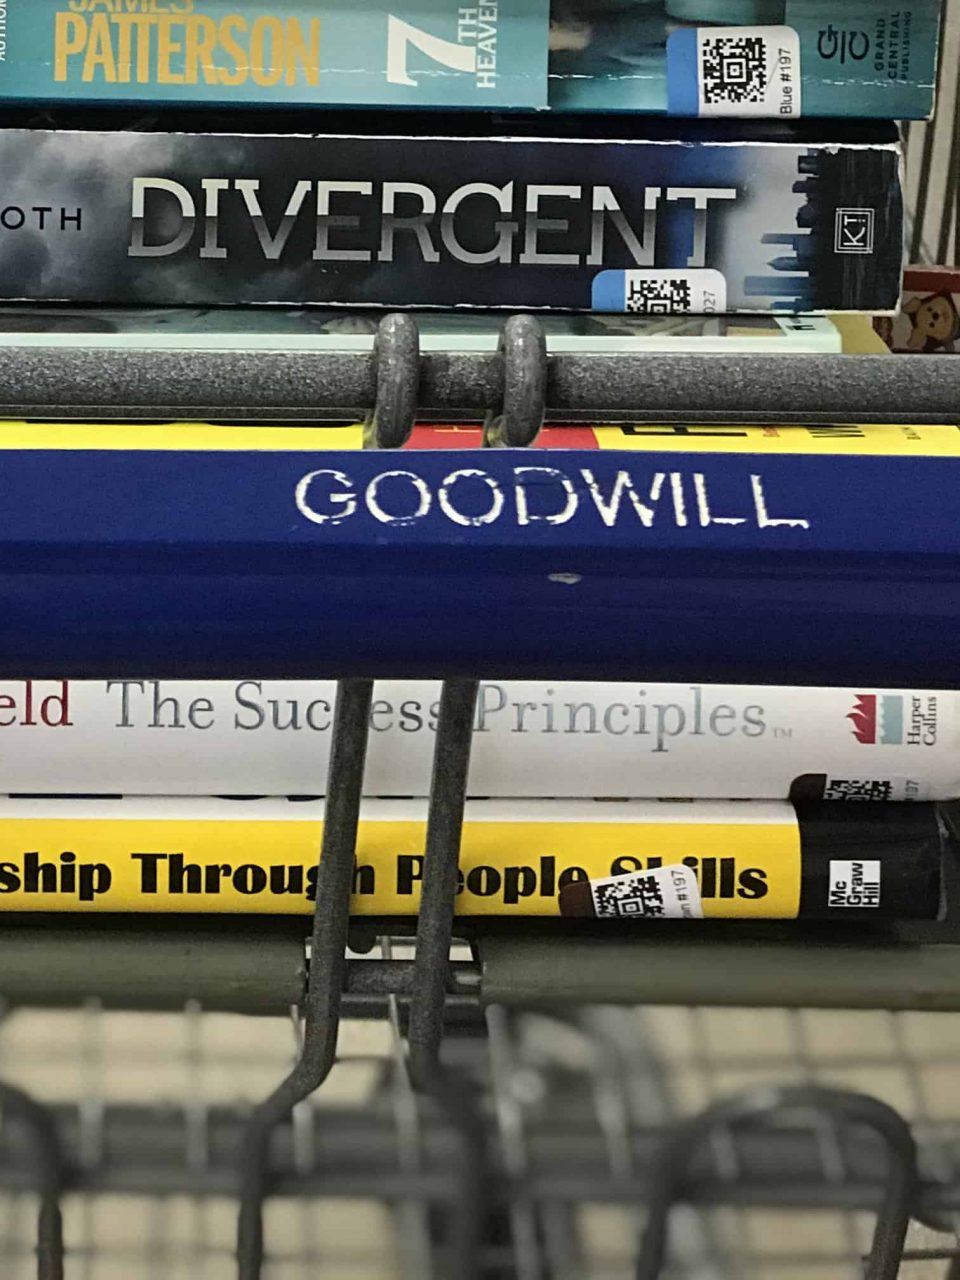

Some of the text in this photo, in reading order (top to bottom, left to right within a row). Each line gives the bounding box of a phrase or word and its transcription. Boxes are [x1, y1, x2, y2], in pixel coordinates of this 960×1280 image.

[54, 11, 321, 87] PATTERSON
[874, 18, 886, 71] GRAND
[888, 11, 900, 80] CENTRAL
[900, 11, 912, 80] PUBLISHING
[780, 48, 793, 115] Blue #197
[127, 177, 737, 268] DIVERGENT
[295, 467, 810, 529] GOODWILL
[106, 681, 216, 730] The
[471, 684, 767, 753] Principles
[907, 696, 925, 745] Harper
[923, 696, 937, 746] Collins
[830, 880, 847, 906] Mc
[847, 862, 864, 906] Graw
[862, 881, 880, 907] Hill
